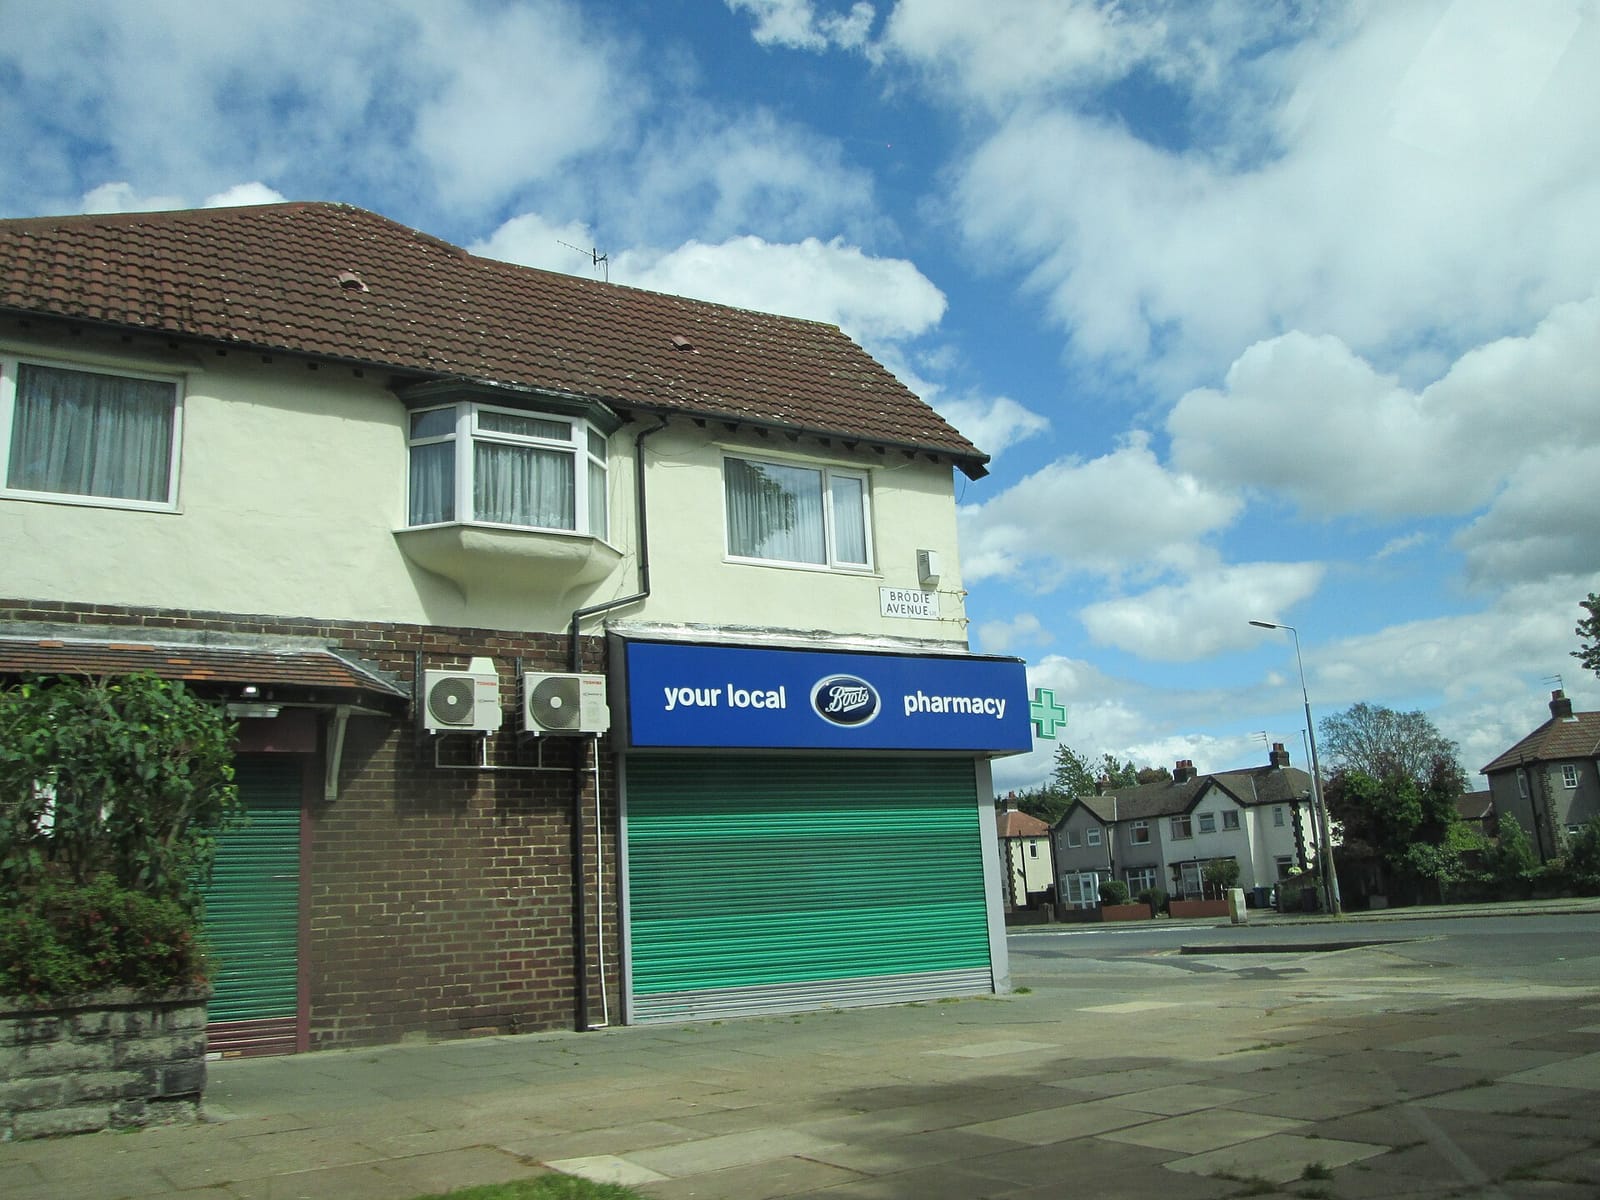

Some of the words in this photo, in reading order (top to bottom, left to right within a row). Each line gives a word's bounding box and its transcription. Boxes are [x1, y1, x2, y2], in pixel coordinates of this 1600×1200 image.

[886, 603, 928, 616] AVENUE
[890, 591, 930, 604] BRODIE
[664, 686, 721, 711] your
[727, 683, 786, 709] local
[825, 685, 869, 713] Boots
[904, 690, 1006, 719] pharmacy
